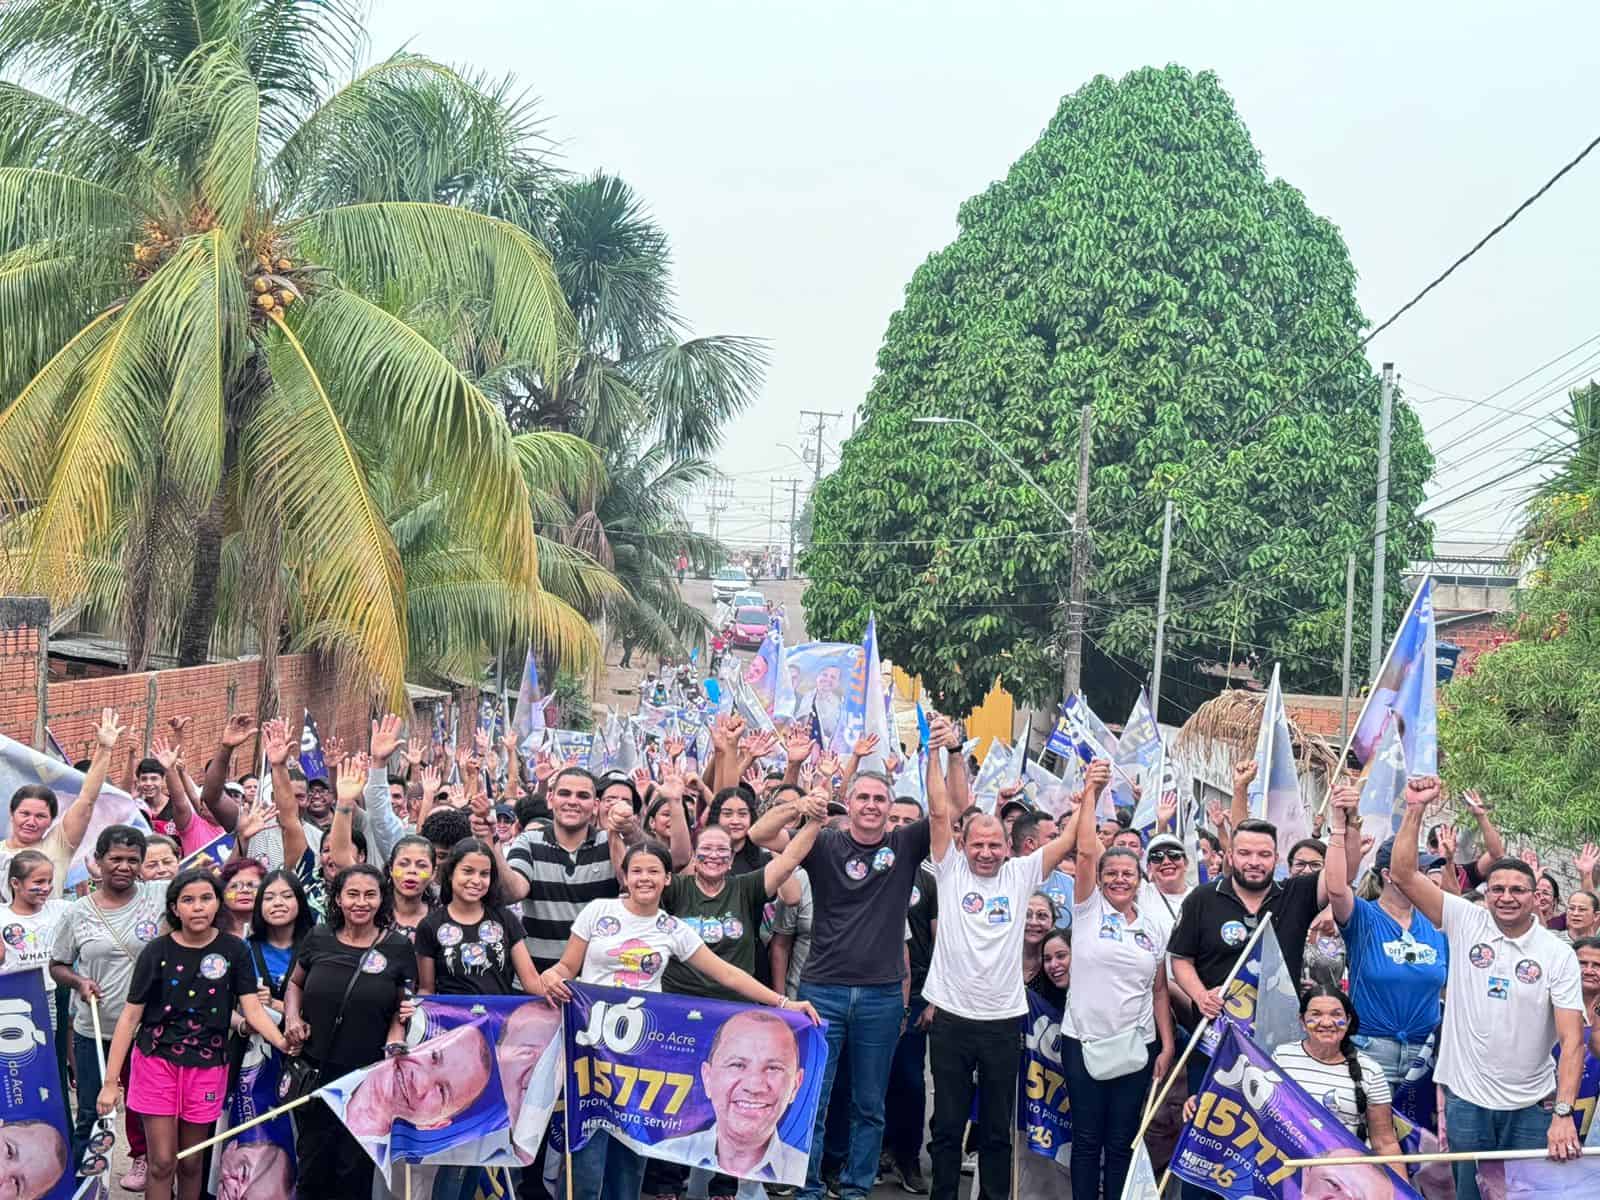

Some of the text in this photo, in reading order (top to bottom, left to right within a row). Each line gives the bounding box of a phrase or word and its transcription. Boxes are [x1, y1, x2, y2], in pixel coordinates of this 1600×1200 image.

[18, 951, 51, 962] WHAT
[575, 996, 646, 1053] JÓ
[648, 1028, 696, 1046] do Acre
[11, 1078, 25, 1105] Acre
[573, 1056, 694, 1115] 15777
[1213, 1054, 1283, 1111] JÓ
[643, 1116, 682, 1131] servir!
[1193, 1091, 1296, 1186] 15777
[1223, 1148, 1252, 1171] para
[1209, 1163, 1237, 1188] 15
